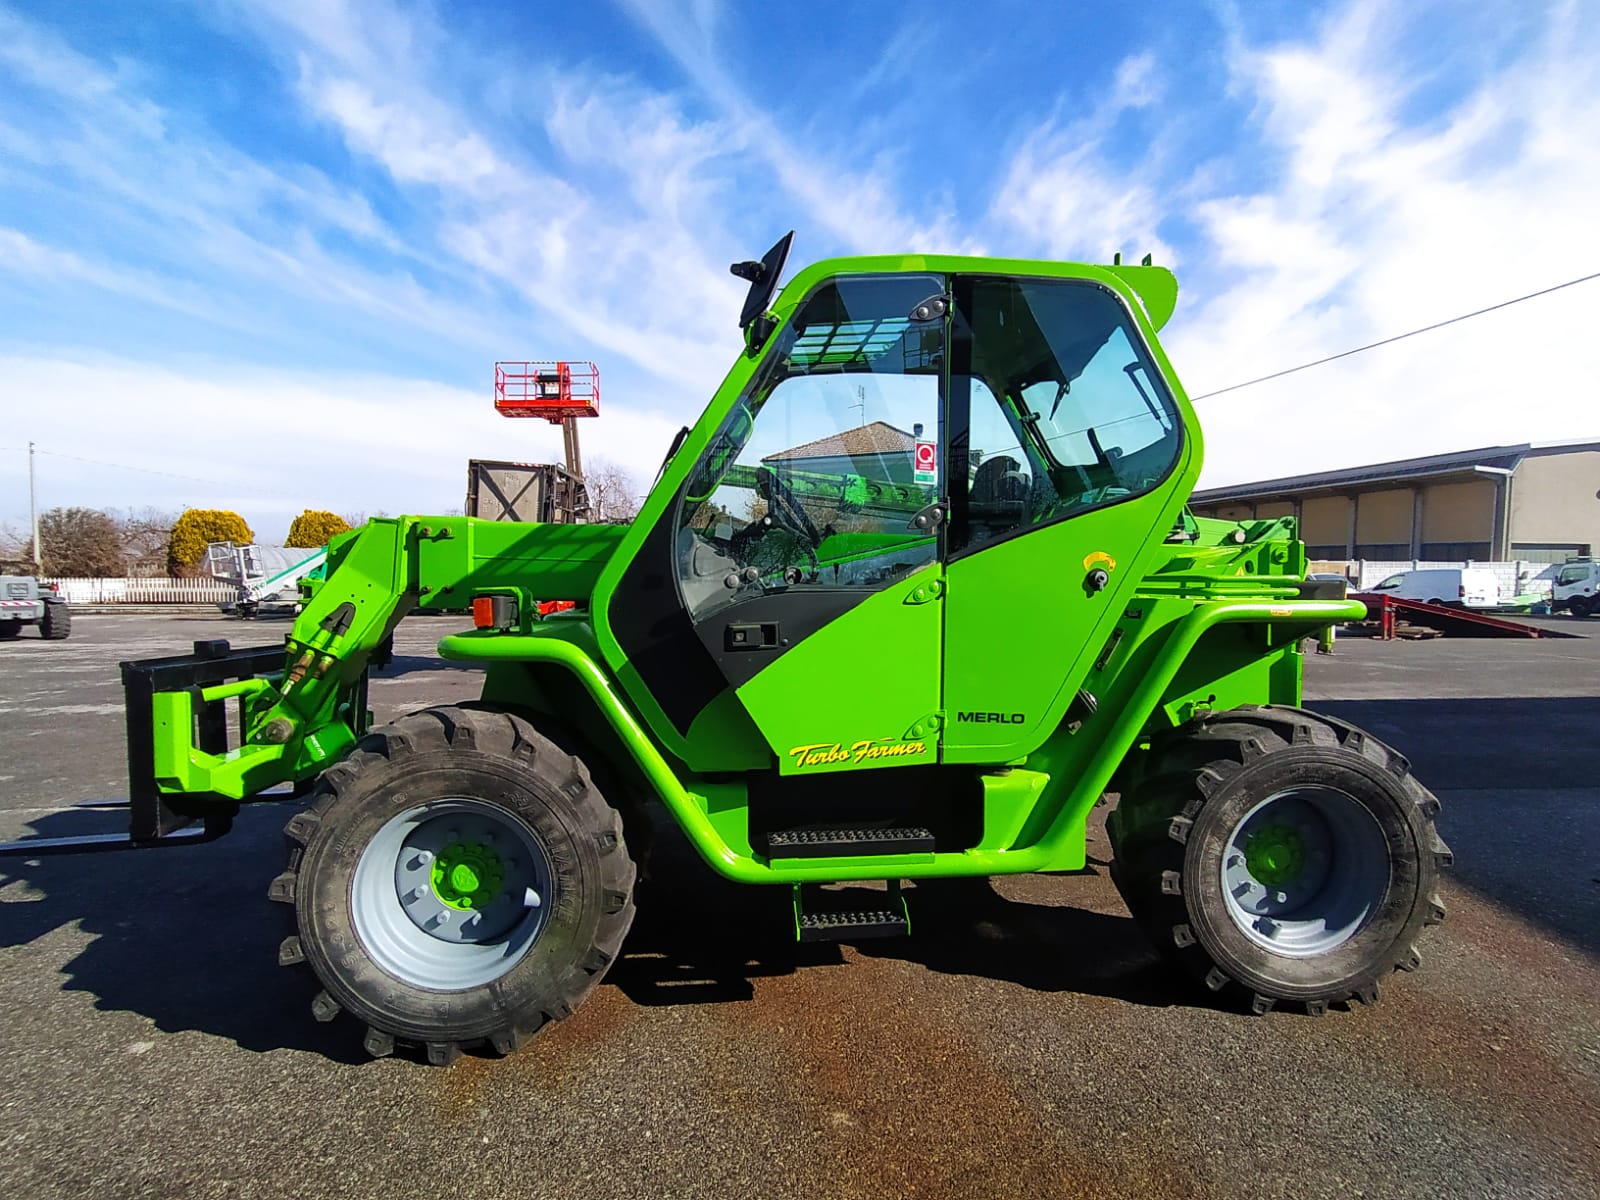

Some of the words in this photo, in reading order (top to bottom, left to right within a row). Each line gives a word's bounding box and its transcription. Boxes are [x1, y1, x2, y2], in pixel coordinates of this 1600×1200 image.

[917, 445, 934, 464] Q
[957, 711, 1025, 724] MERLO
[789, 743, 850, 767] Turbo
[851, 737, 927, 763] Farmer
